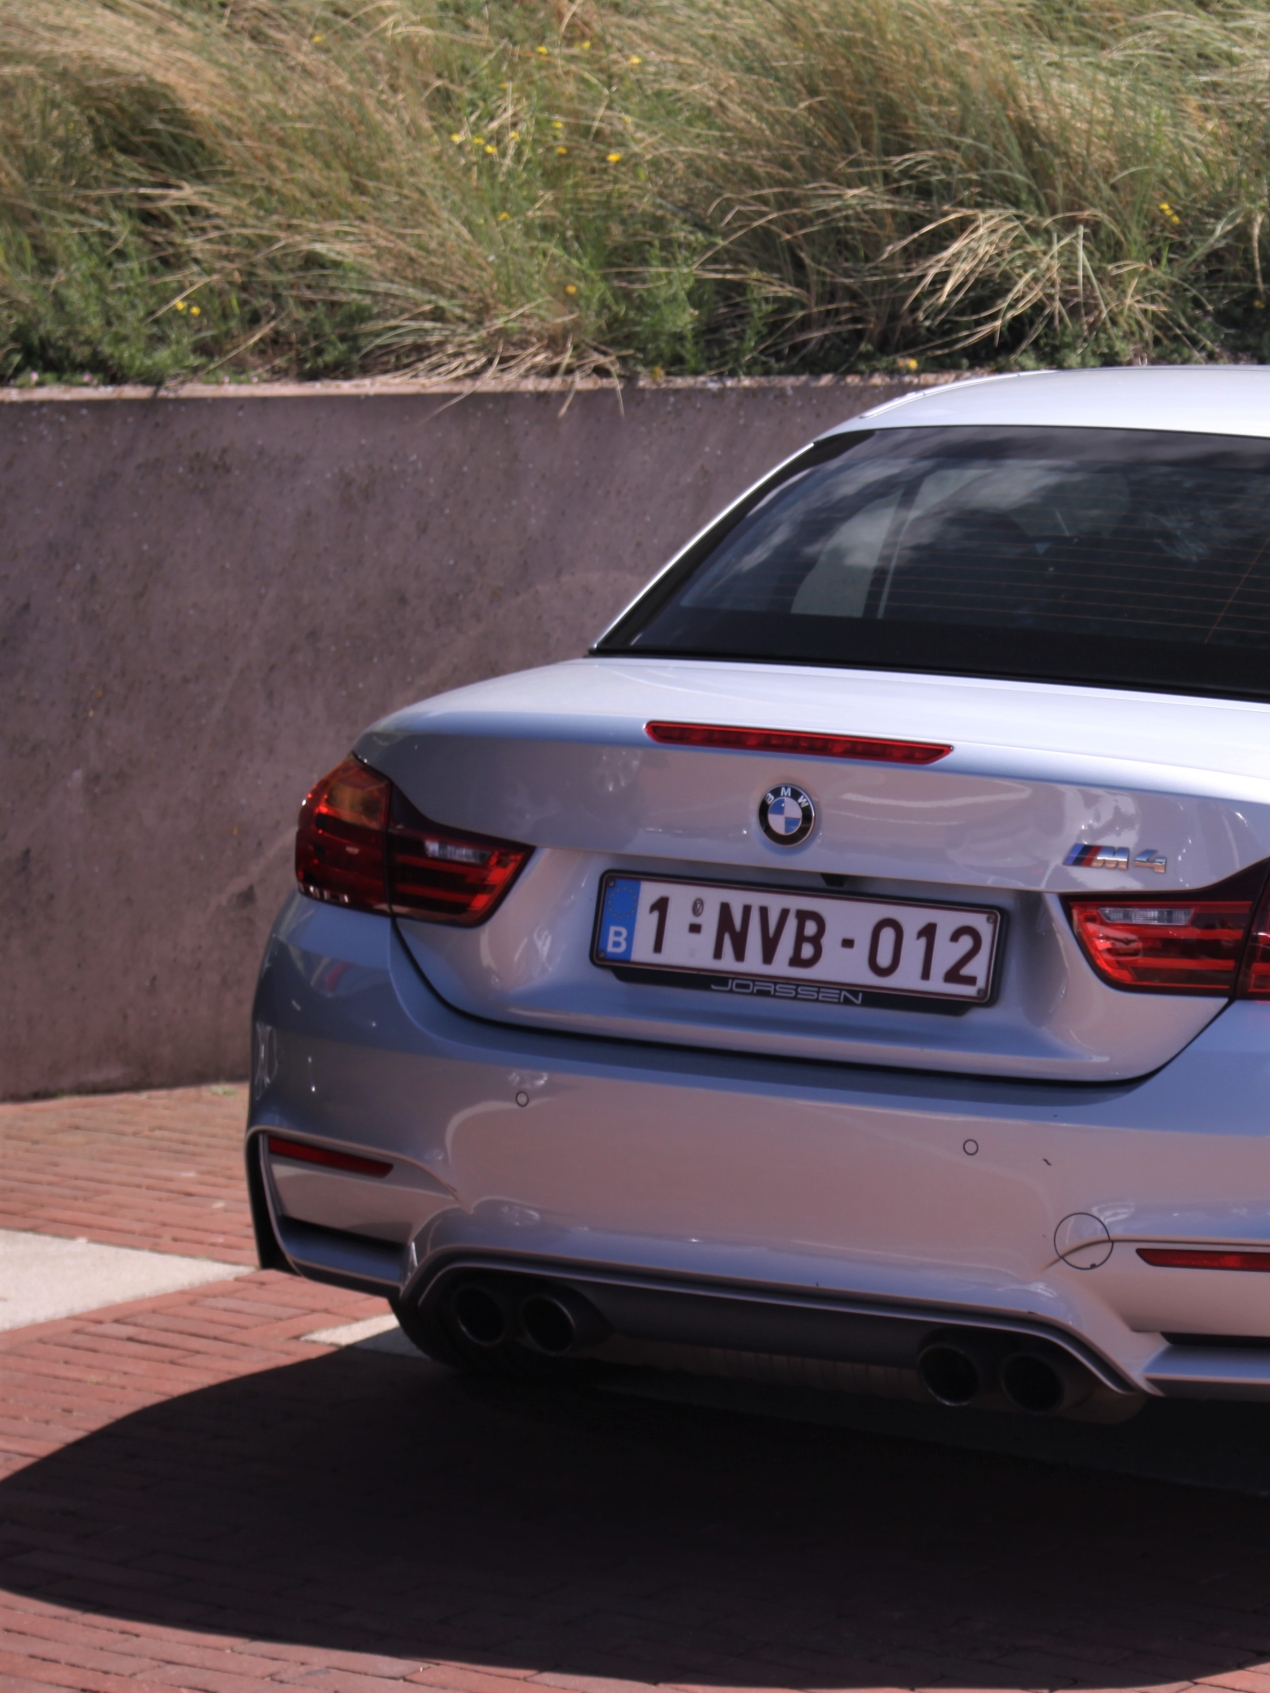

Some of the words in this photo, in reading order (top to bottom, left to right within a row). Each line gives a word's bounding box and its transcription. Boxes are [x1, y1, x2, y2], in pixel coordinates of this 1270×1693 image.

[765, 786, 809, 808] BMW
[1090, 845, 1167, 874] M4
[607, 925, 628, 953] B
[711, 979, 863, 1005] JORSSEN
